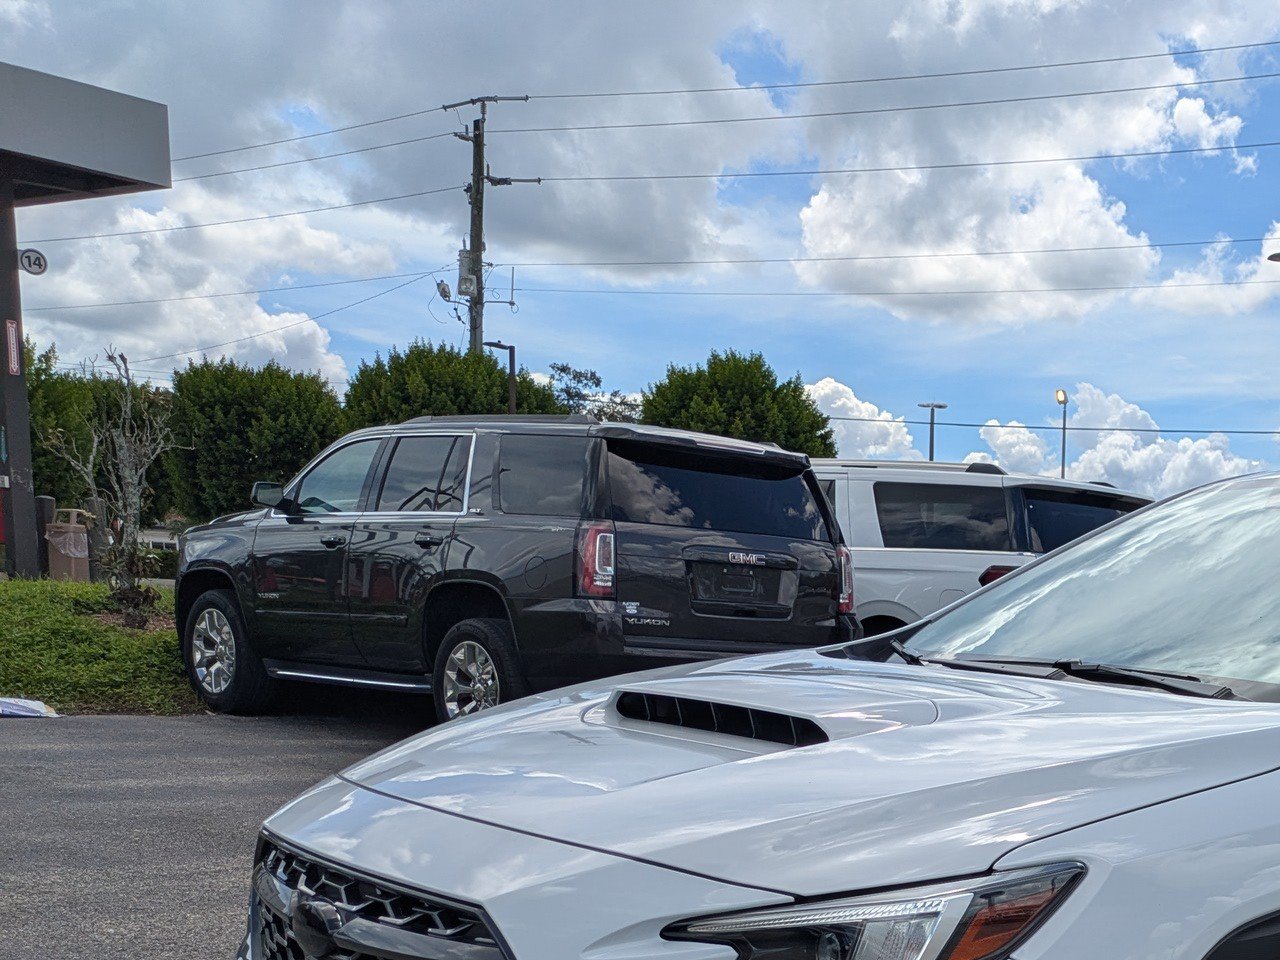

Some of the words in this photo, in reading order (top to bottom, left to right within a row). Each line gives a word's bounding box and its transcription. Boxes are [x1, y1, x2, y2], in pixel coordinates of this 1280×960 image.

[25, 255, 43, 269] 14
[728, 551, 766, 565] GMC
[624, 617, 670, 626] YUKON
